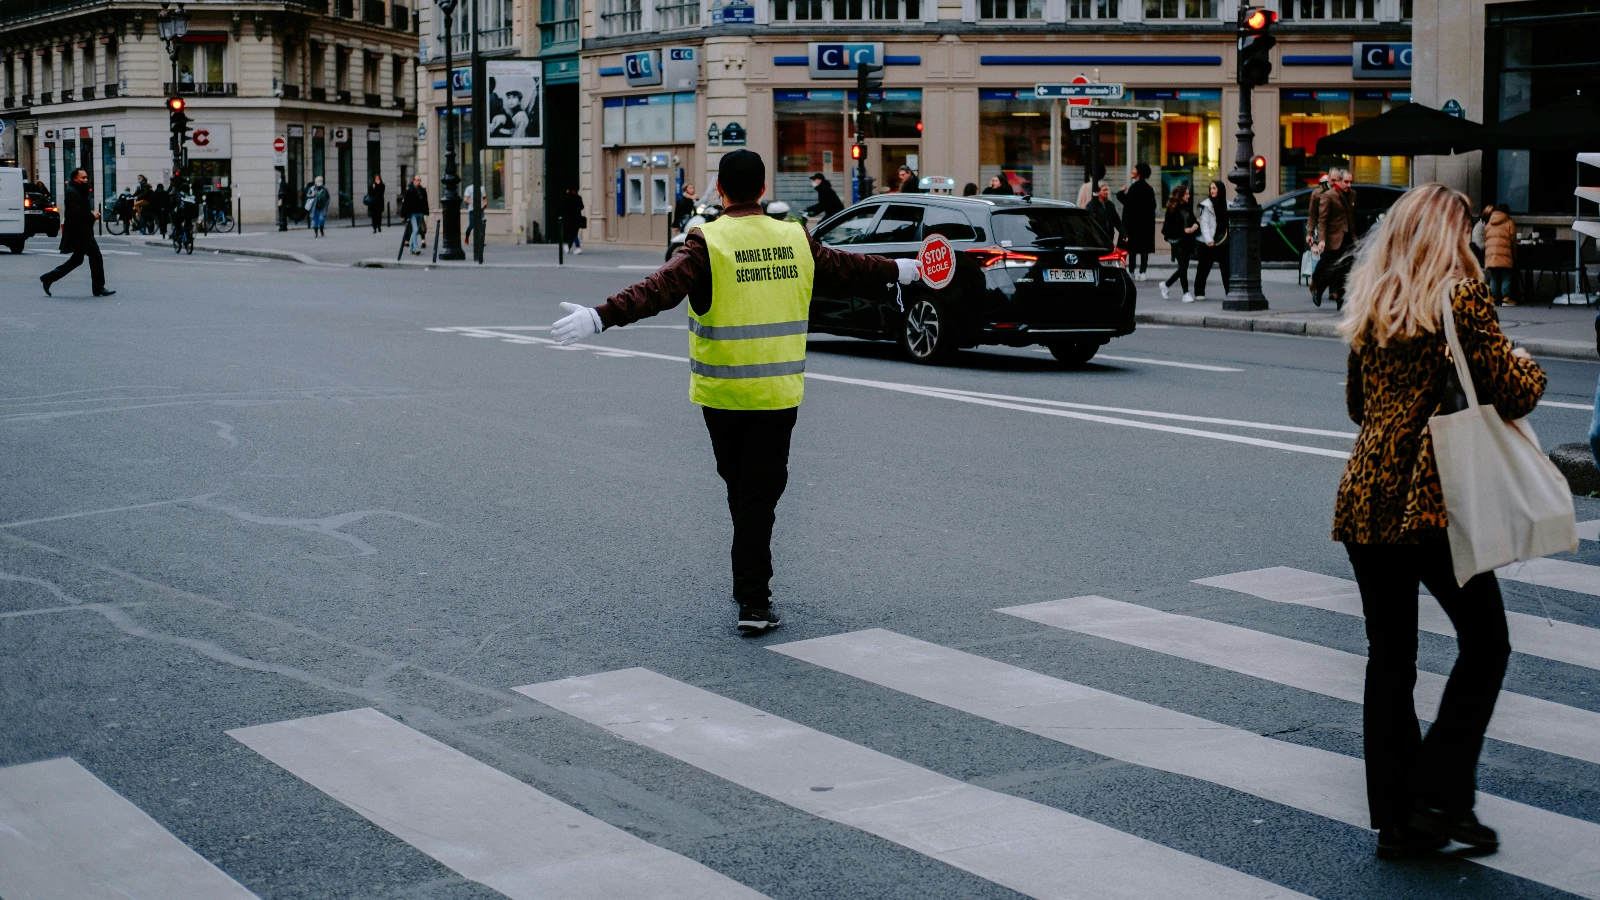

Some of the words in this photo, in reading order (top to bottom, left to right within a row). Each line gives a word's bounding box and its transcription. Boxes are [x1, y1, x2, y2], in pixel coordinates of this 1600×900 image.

[672, 50, 692, 59] CIC
[822, 49, 871, 66] CIC
[1367, 48, 1412, 66] CIC
[627, 57, 650, 75] CIC
[453, 72, 470, 88] CIC
[1083, 110, 1109, 119] Passage
[734, 248, 762, 263] MAIRIE
[762, 247, 773, 262] DE
[772, 245, 794, 261] PARIS
[924, 246, 947, 265] STOP
[736, 264, 772, 283] SÉCURITÉ
[772, 263, 799, 280] ÉCOLES
